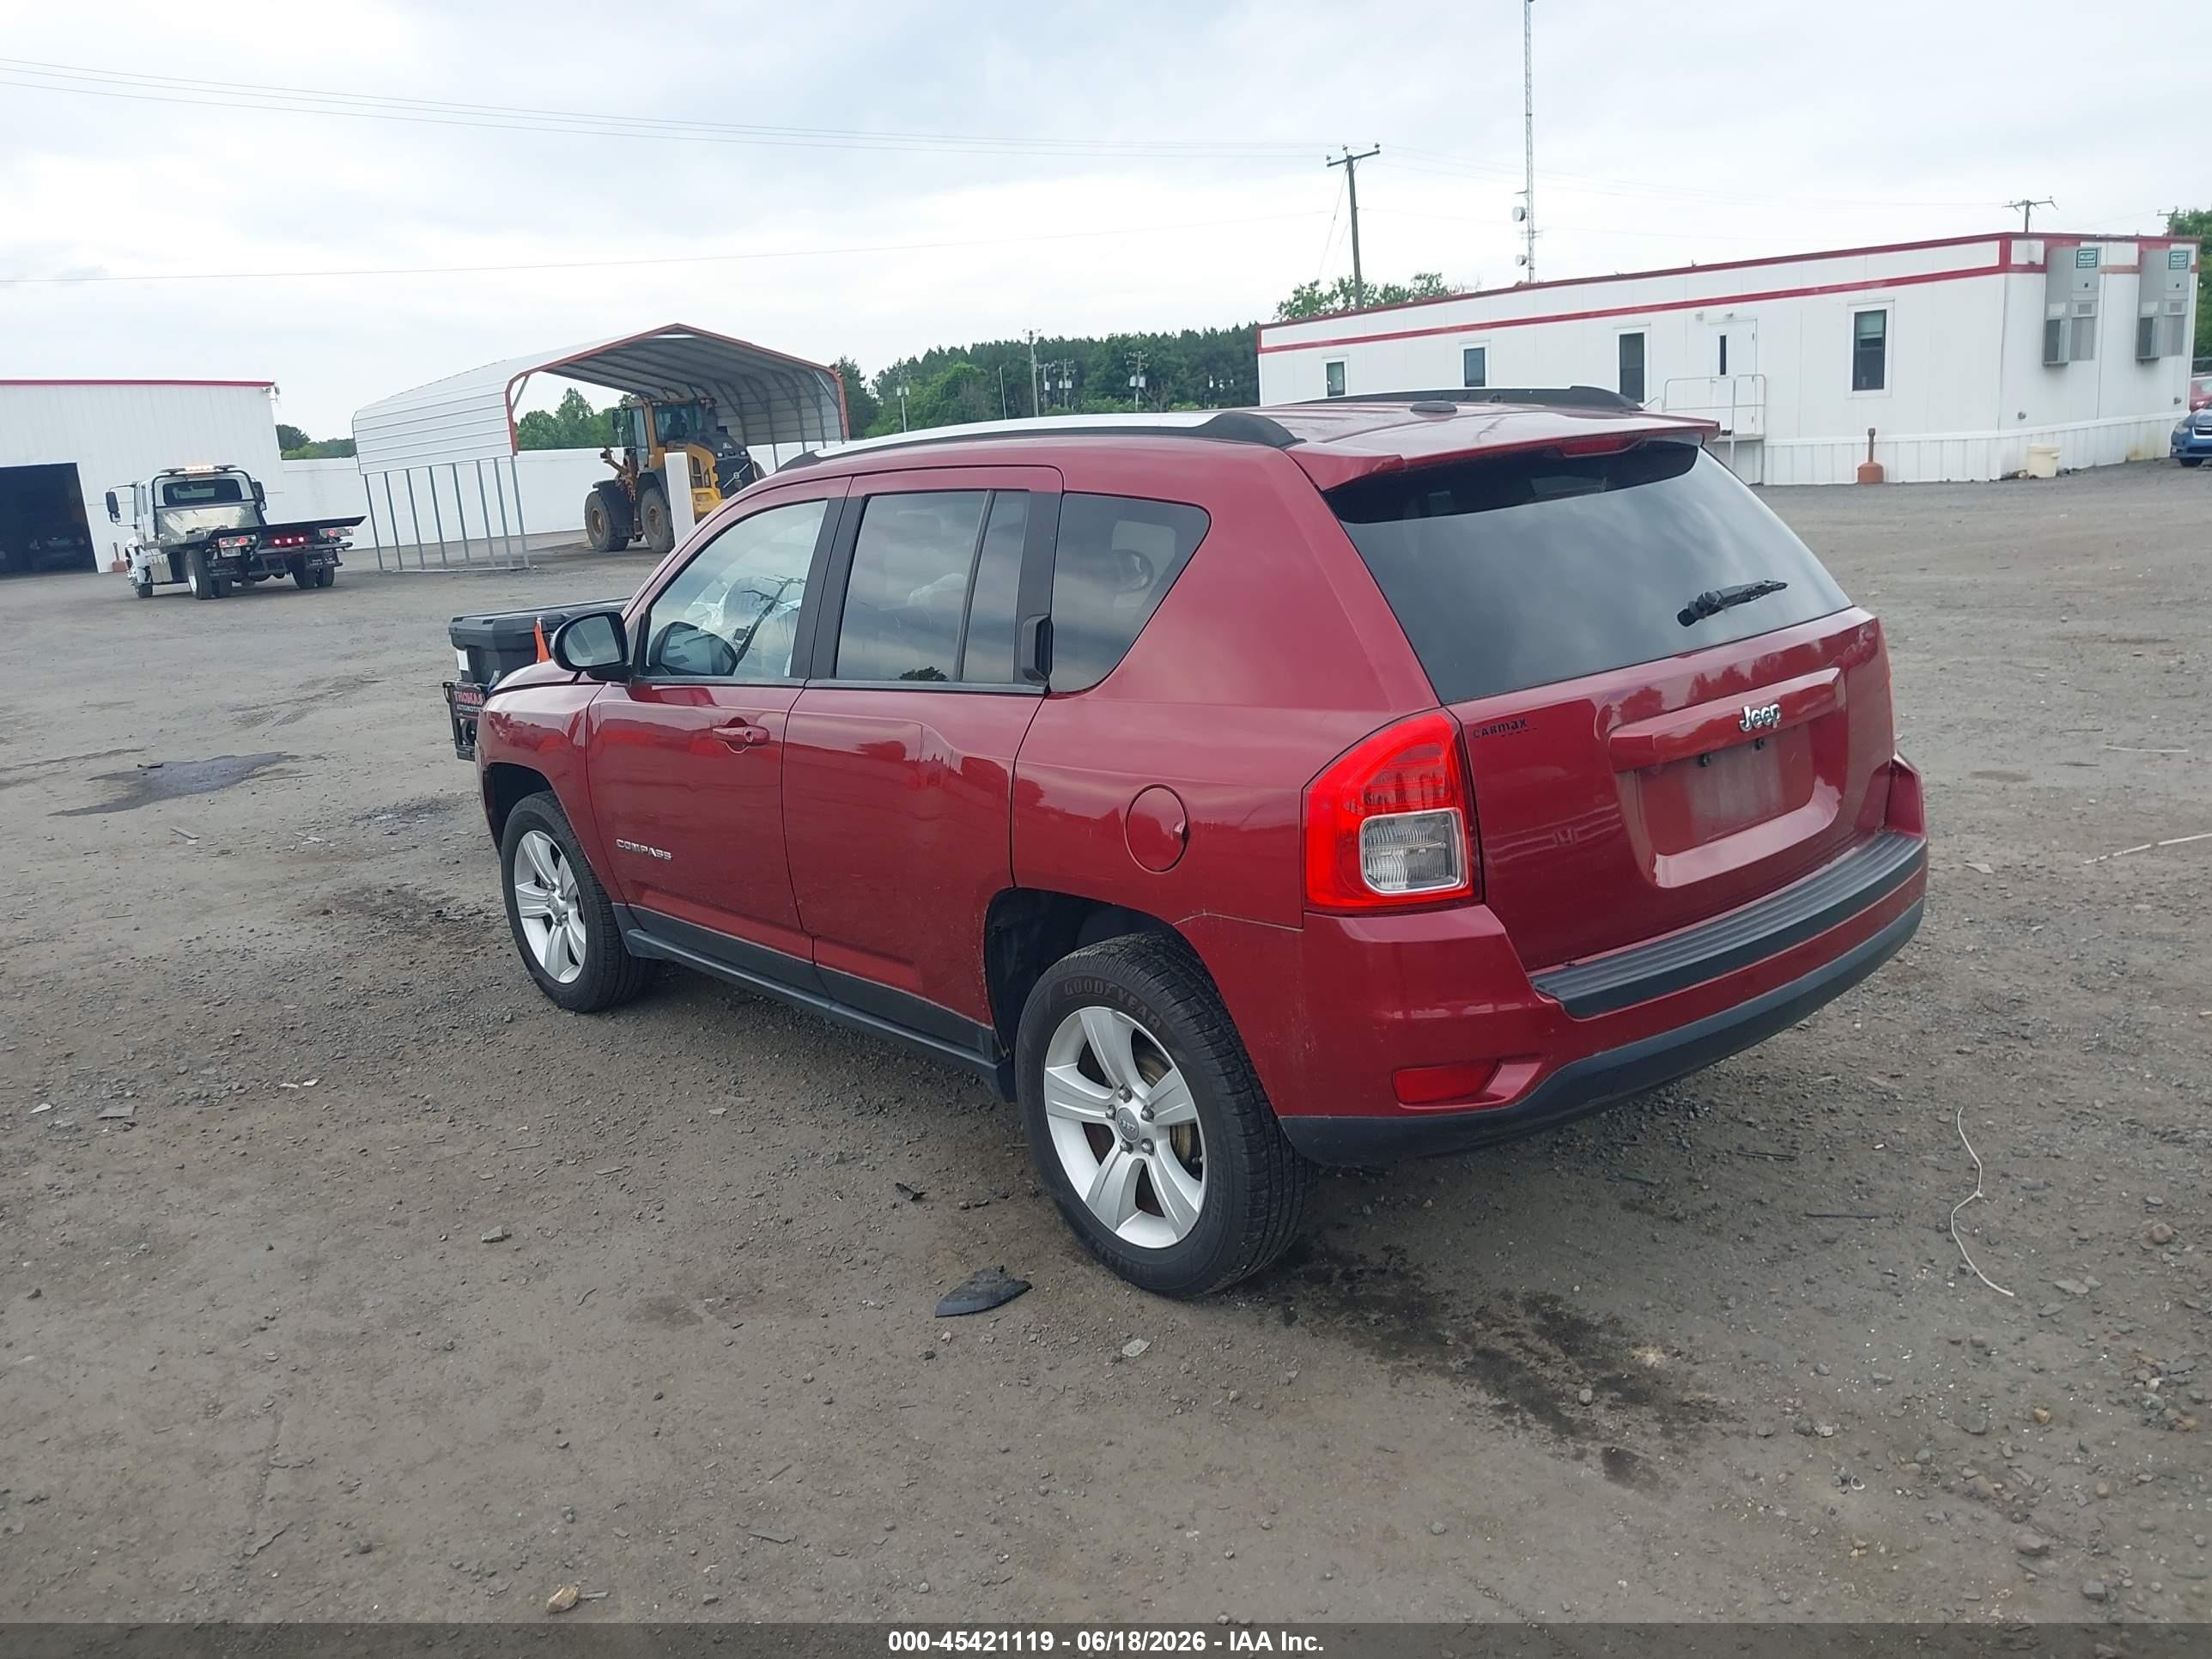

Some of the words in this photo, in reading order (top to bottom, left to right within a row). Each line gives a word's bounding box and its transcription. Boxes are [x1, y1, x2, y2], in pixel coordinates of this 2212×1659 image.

[453, 690, 483, 705] THOMAS
[1739, 703, 1781, 732] Jeep
[616, 838, 672, 861] COMPASS
